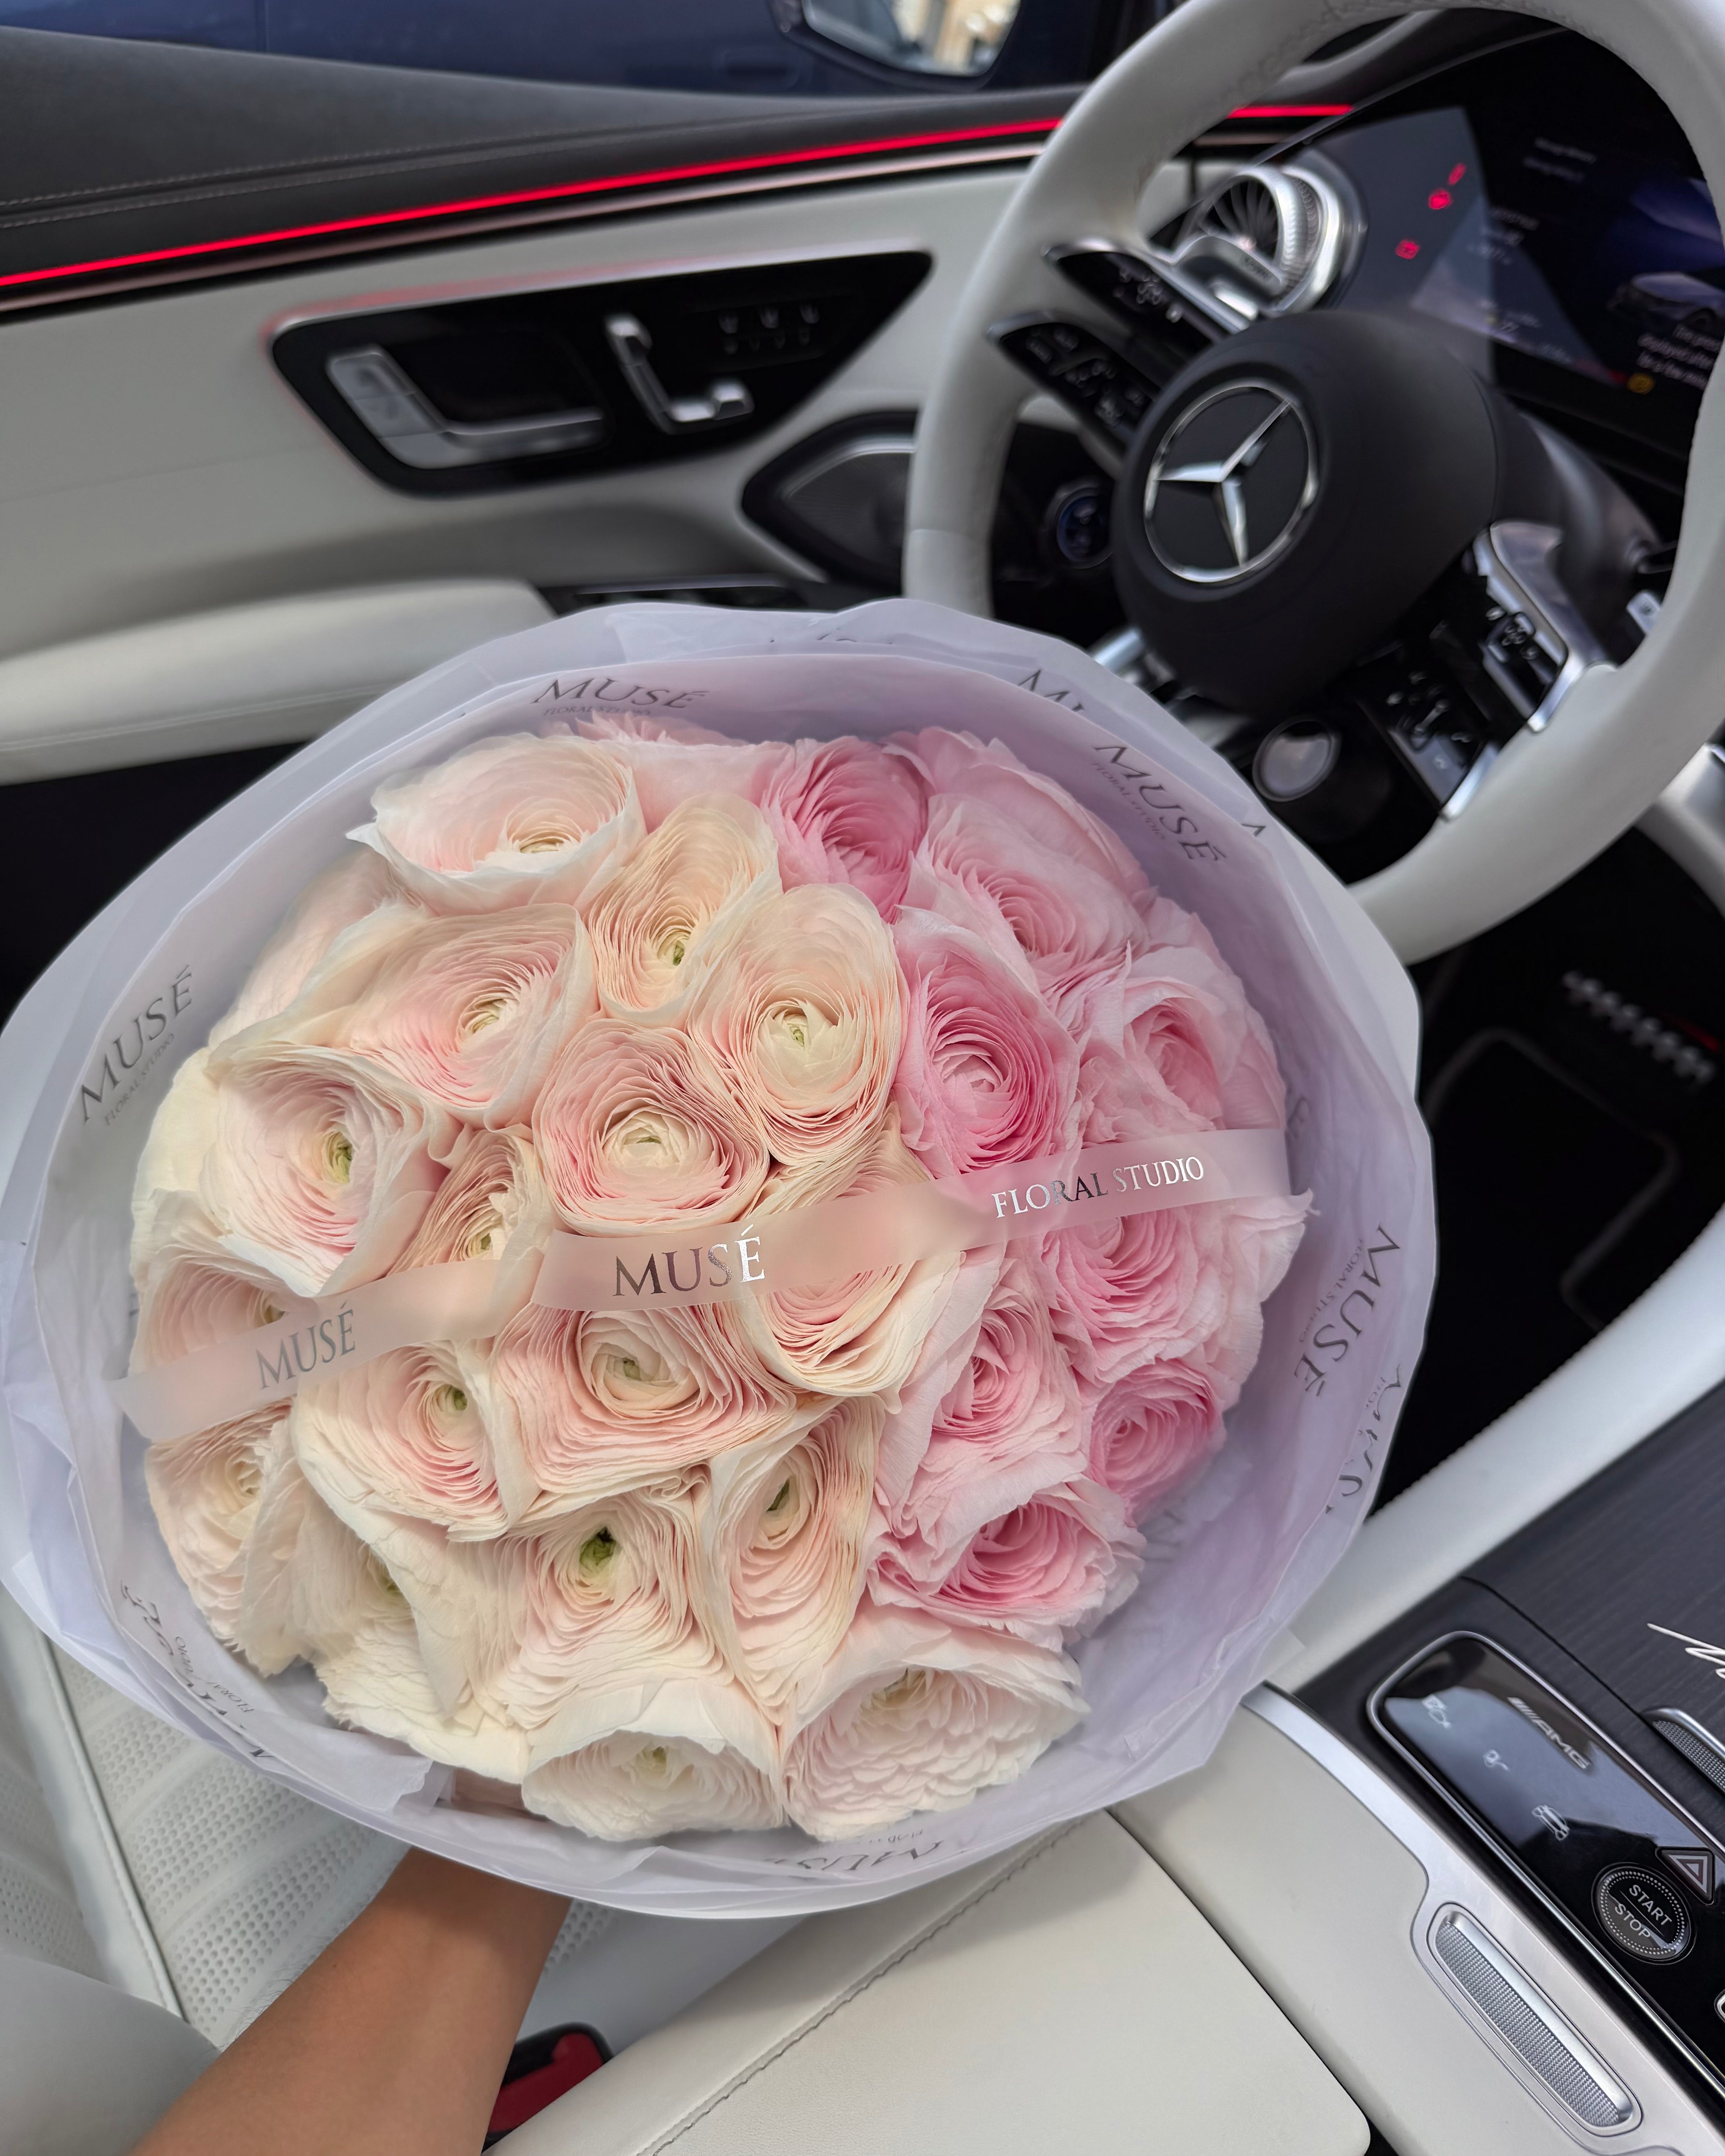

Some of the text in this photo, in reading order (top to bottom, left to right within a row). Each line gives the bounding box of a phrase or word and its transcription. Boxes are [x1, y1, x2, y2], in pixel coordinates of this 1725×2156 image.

[1093, 747, 1226, 861] MUSÉ
[82, 964, 192, 1124] MUSÉ
[991, 1157, 1203, 1218] FLORAL STUDIO
[613, 1224, 765, 1296] MUSÉ
[256, 1301, 355, 1390] MUSÉ
[1294, 1223, 1400, 1397] MUSÉ
[1615, 1904, 1650, 1937] STOP
[1630, 1885, 1672, 1925] START
